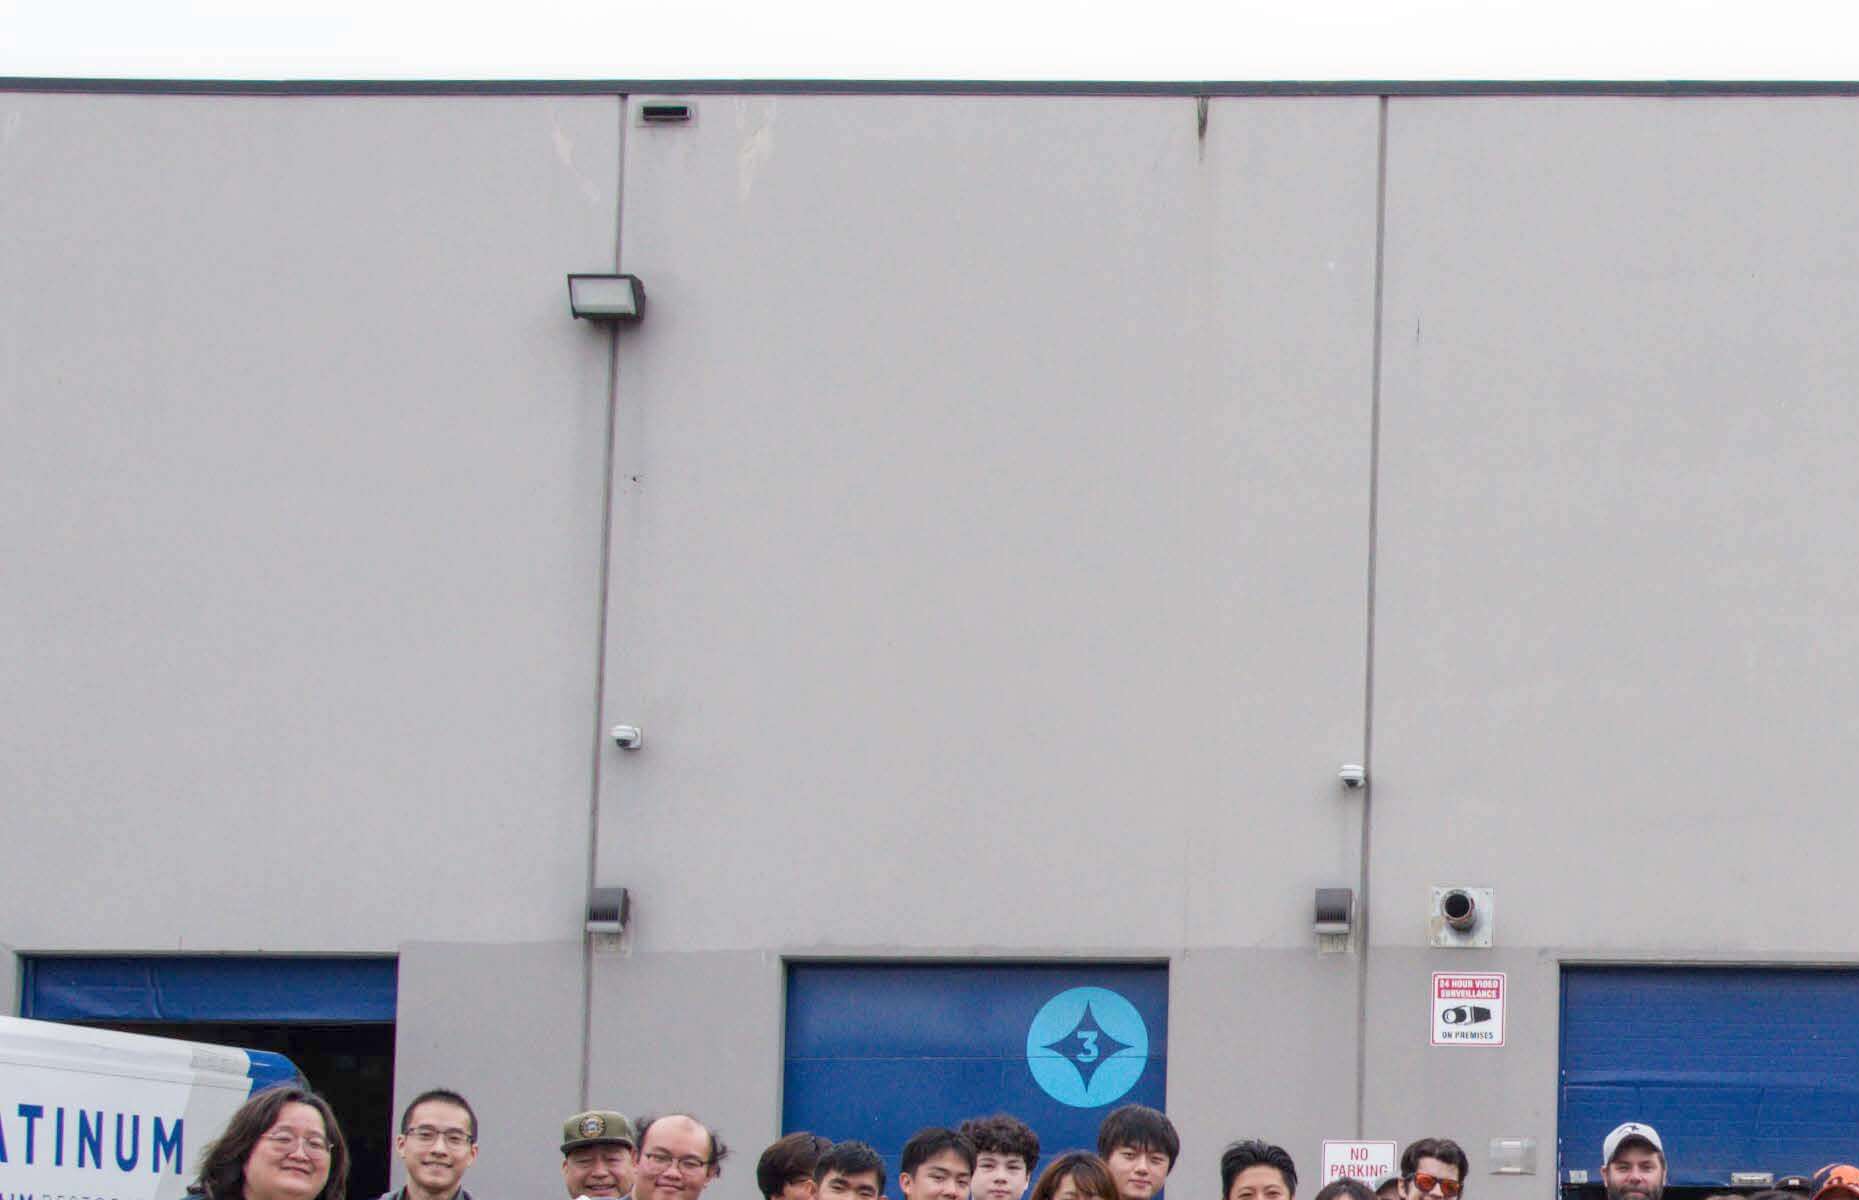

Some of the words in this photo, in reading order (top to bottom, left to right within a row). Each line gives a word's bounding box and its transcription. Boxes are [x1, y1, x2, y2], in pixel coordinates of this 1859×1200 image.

[1440, 979, 1450, 988] 24
[1452, 979, 1473, 988] HOUR
[1475, 979, 1499, 989] VIDEO
[1440, 989, 1498, 998] SURVEILLANCE
[1442, 1031, 1453, 1039] ON
[1455, 1031, 1494, 1040] PREMISES
[1076, 1030, 1099, 1063] 3
[1350, 1147, 1369, 1161] NO
[1330, 1164, 1389, 1177] PARKING
